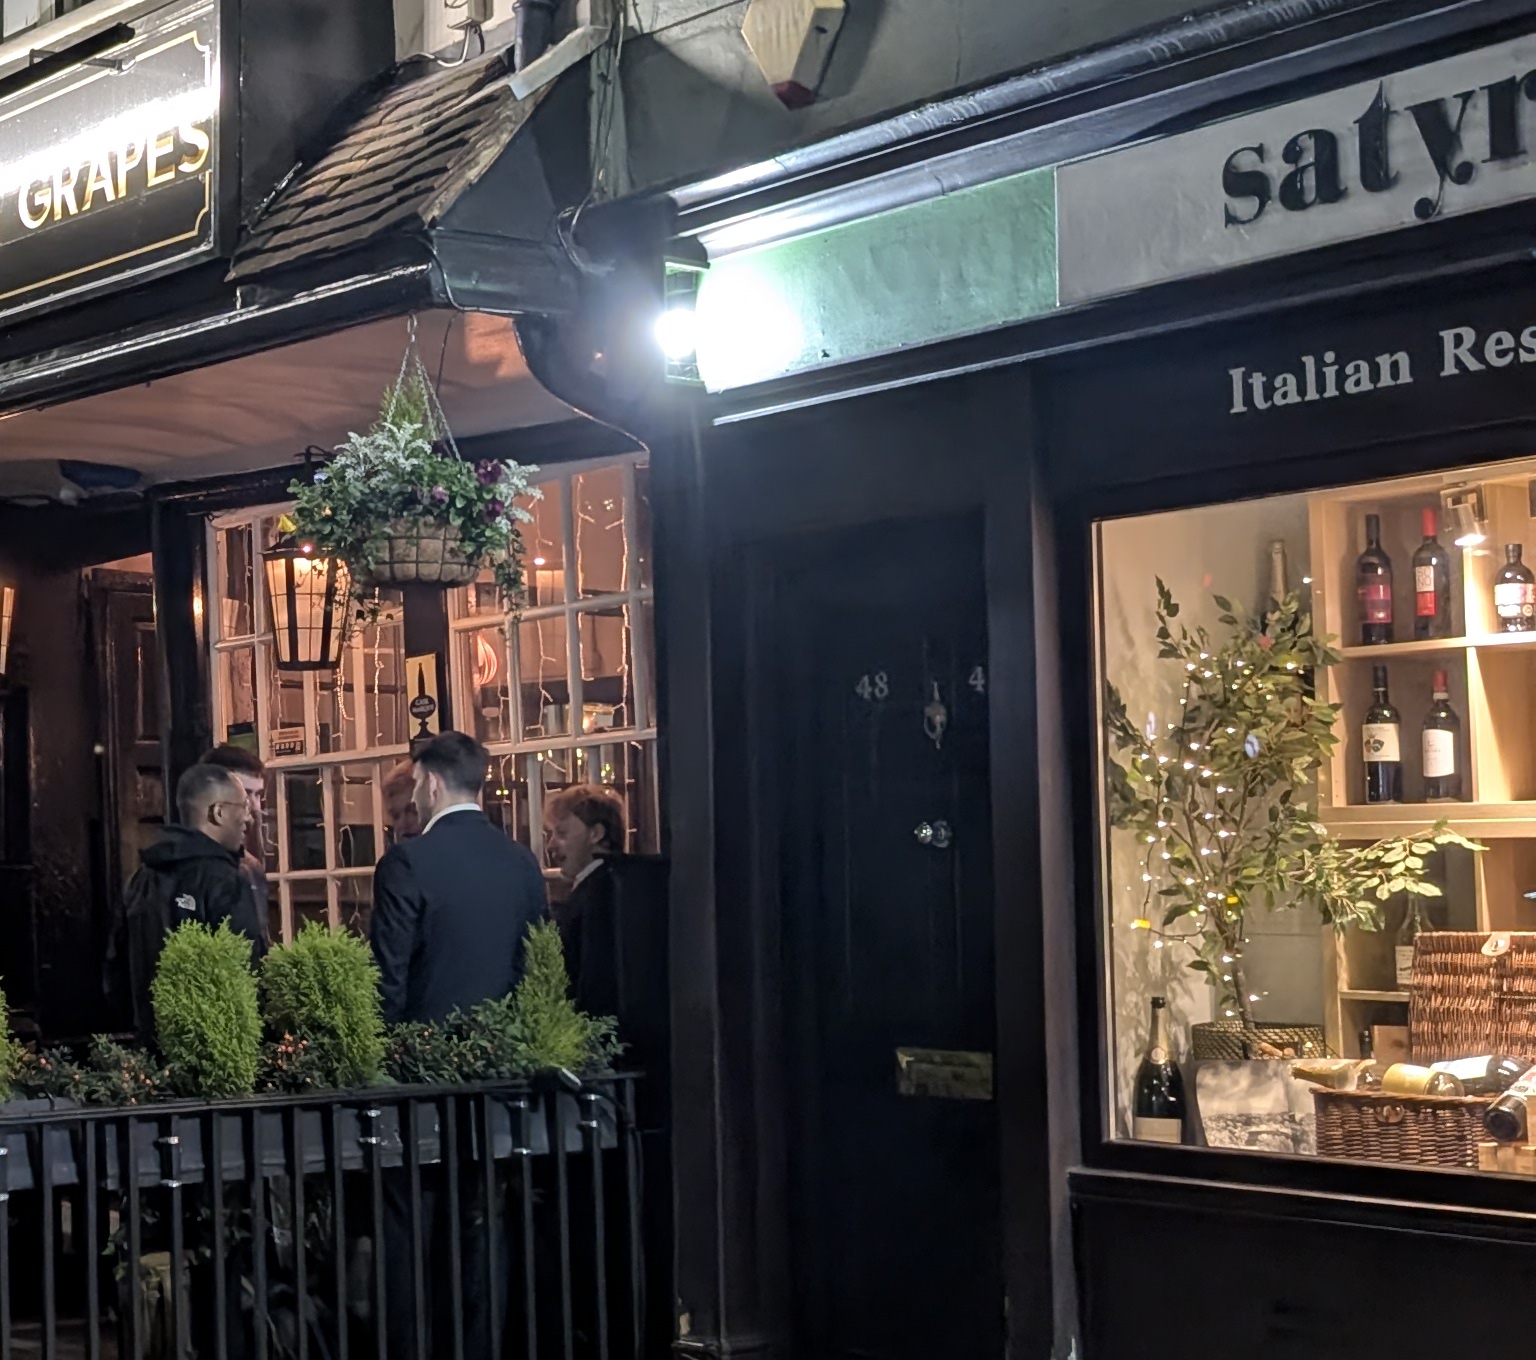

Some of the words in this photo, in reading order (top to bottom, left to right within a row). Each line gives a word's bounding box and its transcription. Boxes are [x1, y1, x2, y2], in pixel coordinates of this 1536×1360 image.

[17, 122, 211, 230] GRAPES
[1228, 350, 1414, 415] Italian
[855, 671, 889, 699] 48
